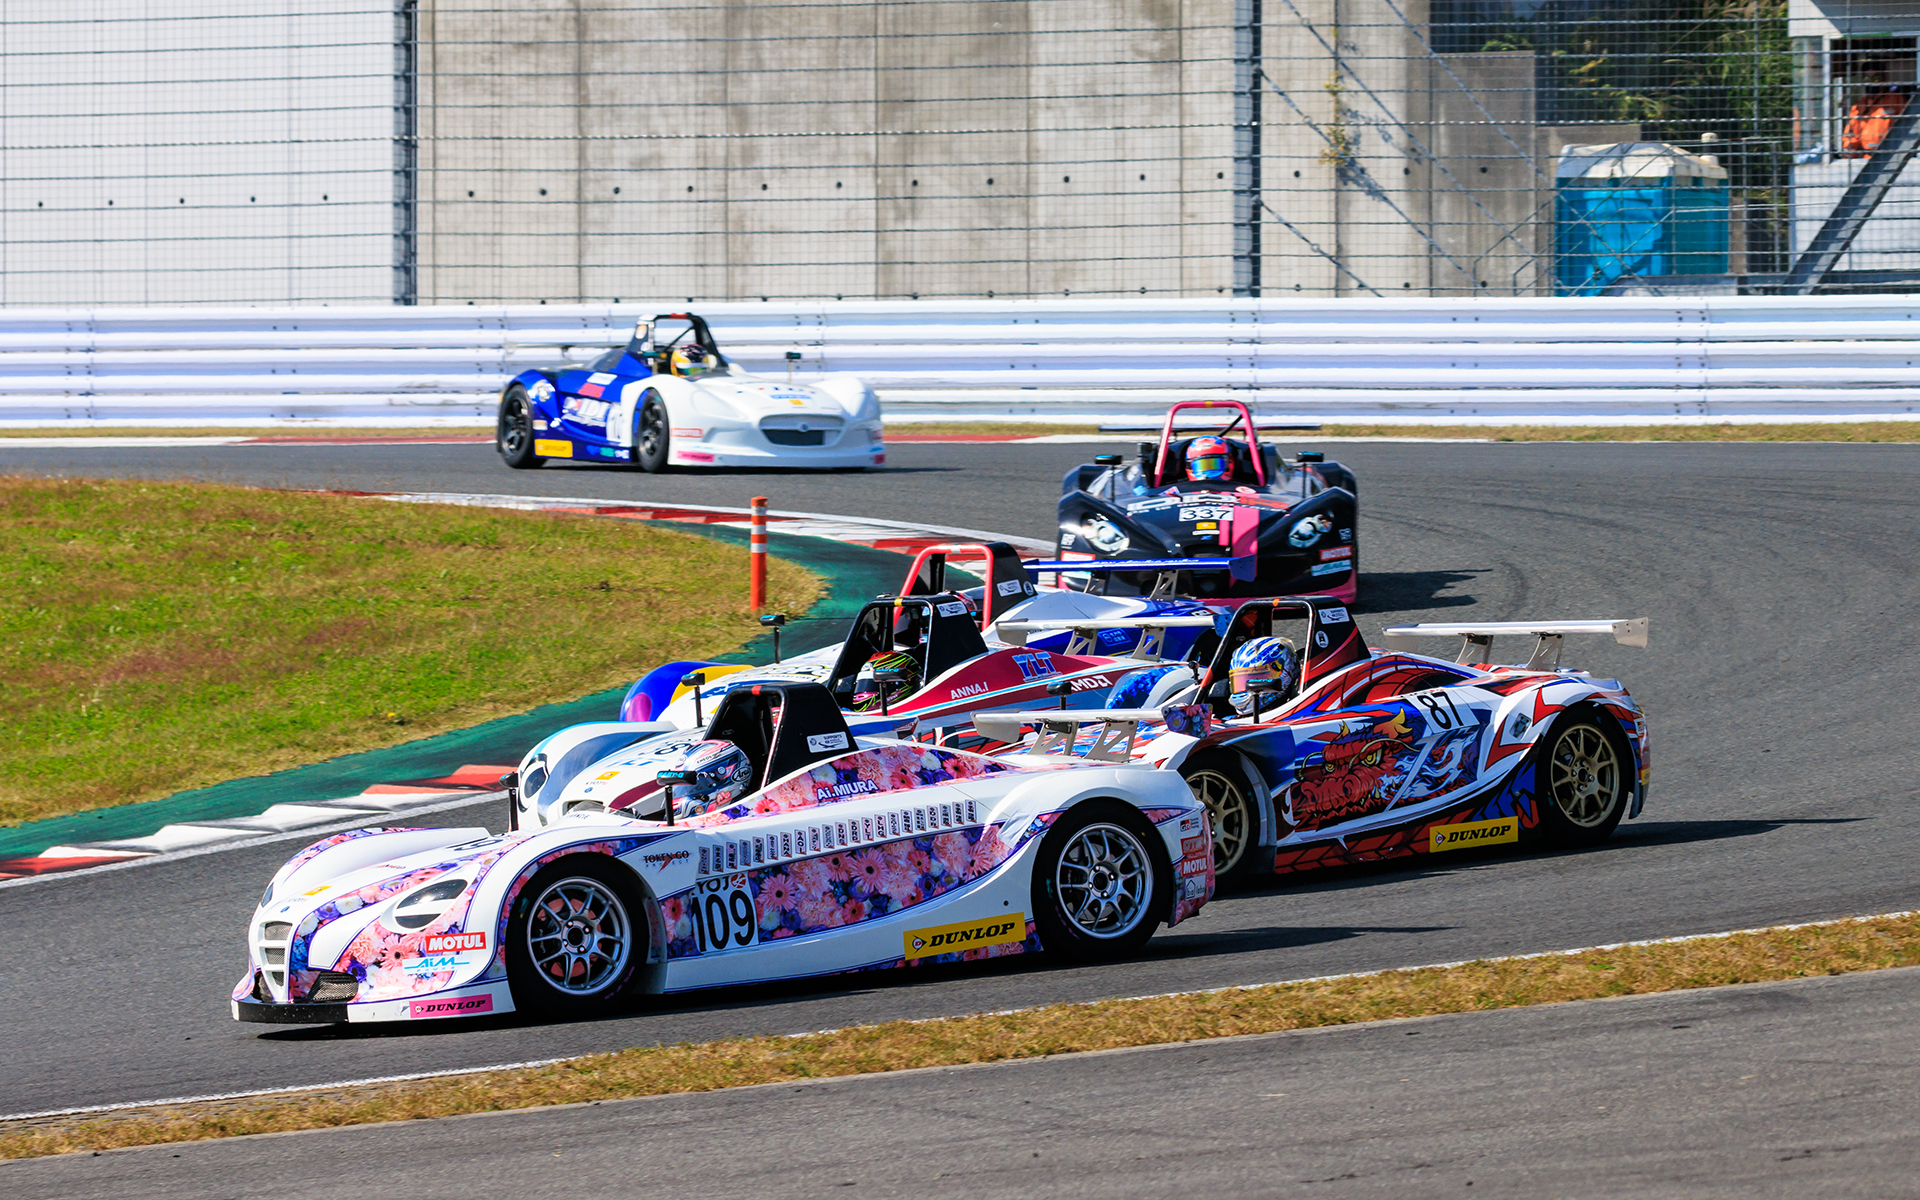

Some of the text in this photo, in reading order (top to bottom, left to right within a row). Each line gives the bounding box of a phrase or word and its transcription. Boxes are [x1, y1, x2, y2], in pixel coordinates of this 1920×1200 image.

[1182, 509, 1231, 520] 337
[1012, 652, 1056, 678] YLT
[950, 682, 989, 700] ANNA.I
[1417, 692, 1464, 729] 87
[817, 779, 879, 799] Ai.MIURA
[1447, 825, 1511, 843] DUNLOP
[643, 850, 690, 863] TOKEN GO
[1183, 858, 1207, 874] MOTUL
[691, 890, 755, 952] 109
[428, 934, 484, 951] MOTUL
[929, 922, 1015, 947] DUNLOP
[426, 1000, 487, 1012] DUNLOP
